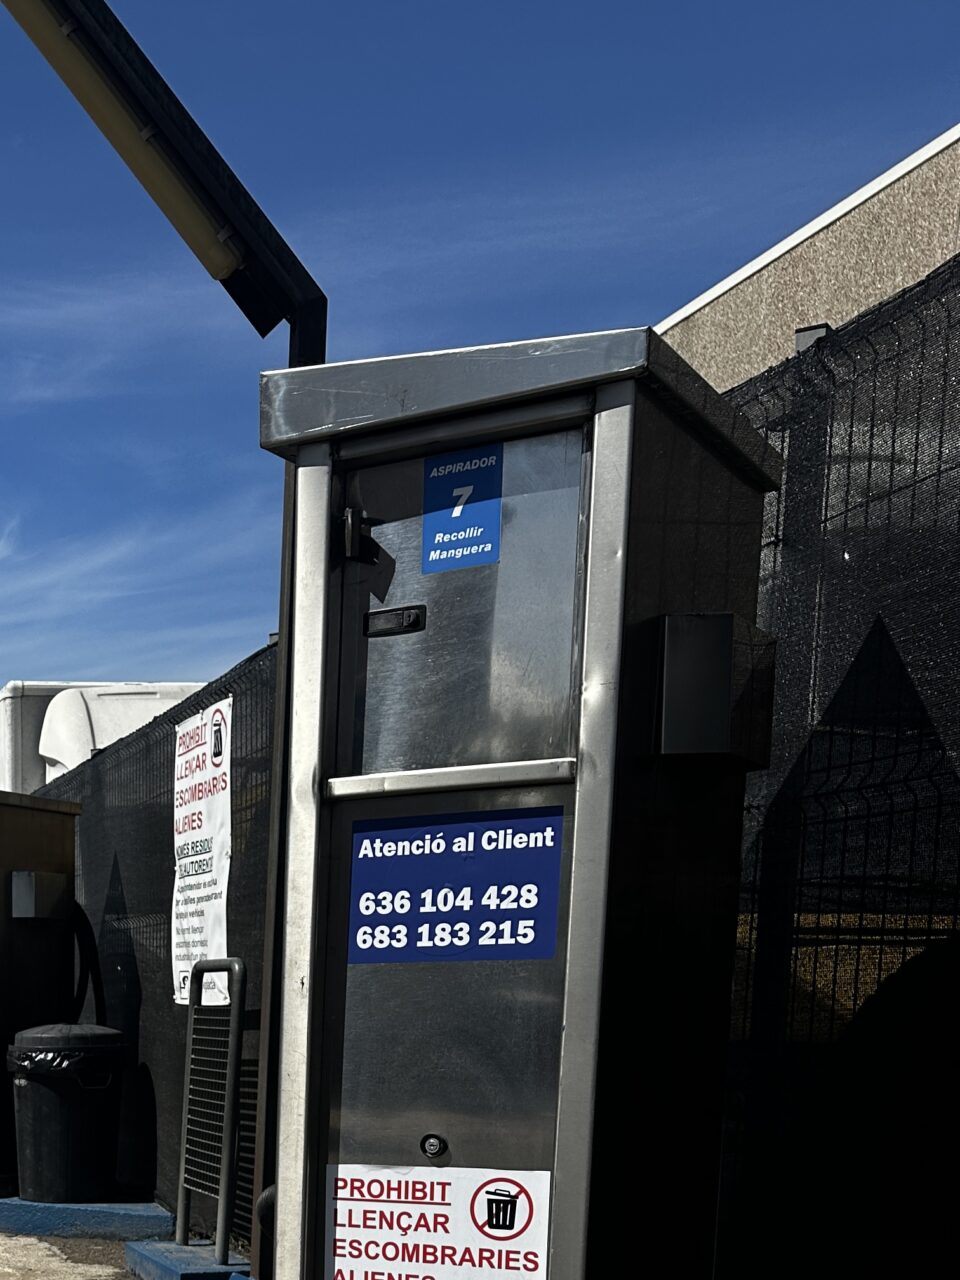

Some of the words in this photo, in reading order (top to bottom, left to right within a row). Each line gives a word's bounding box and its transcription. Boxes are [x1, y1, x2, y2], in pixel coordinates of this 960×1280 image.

[430, 456, 497, 478] ASPIRADOR
[451, 485, 474, 518] 7
[434, 526, 484, 544] Recollir
[429, 541, 492, 561] Manguera
[176, 771, 227, 808] ESCOMBRARS
[358, 832, 445, 859] Atenció
[452, 831, 474, 853] al
[481, 826, 555, 851] Client
[358, 890, 411, 916] 636
[419, 886, 473, 913] 104
[481, 883, 538, 910] 428
[356, 924, 408, 949] 683
[416, 922, 470, 948] 183
[478, 919, 535, 946] 215
[334, 1177, 452, 1202] PROHIBIT
[333, 1207, 451, 1236] LLENÇAR
[332, 1238, 540, 1272] ESCOMBRARIES
